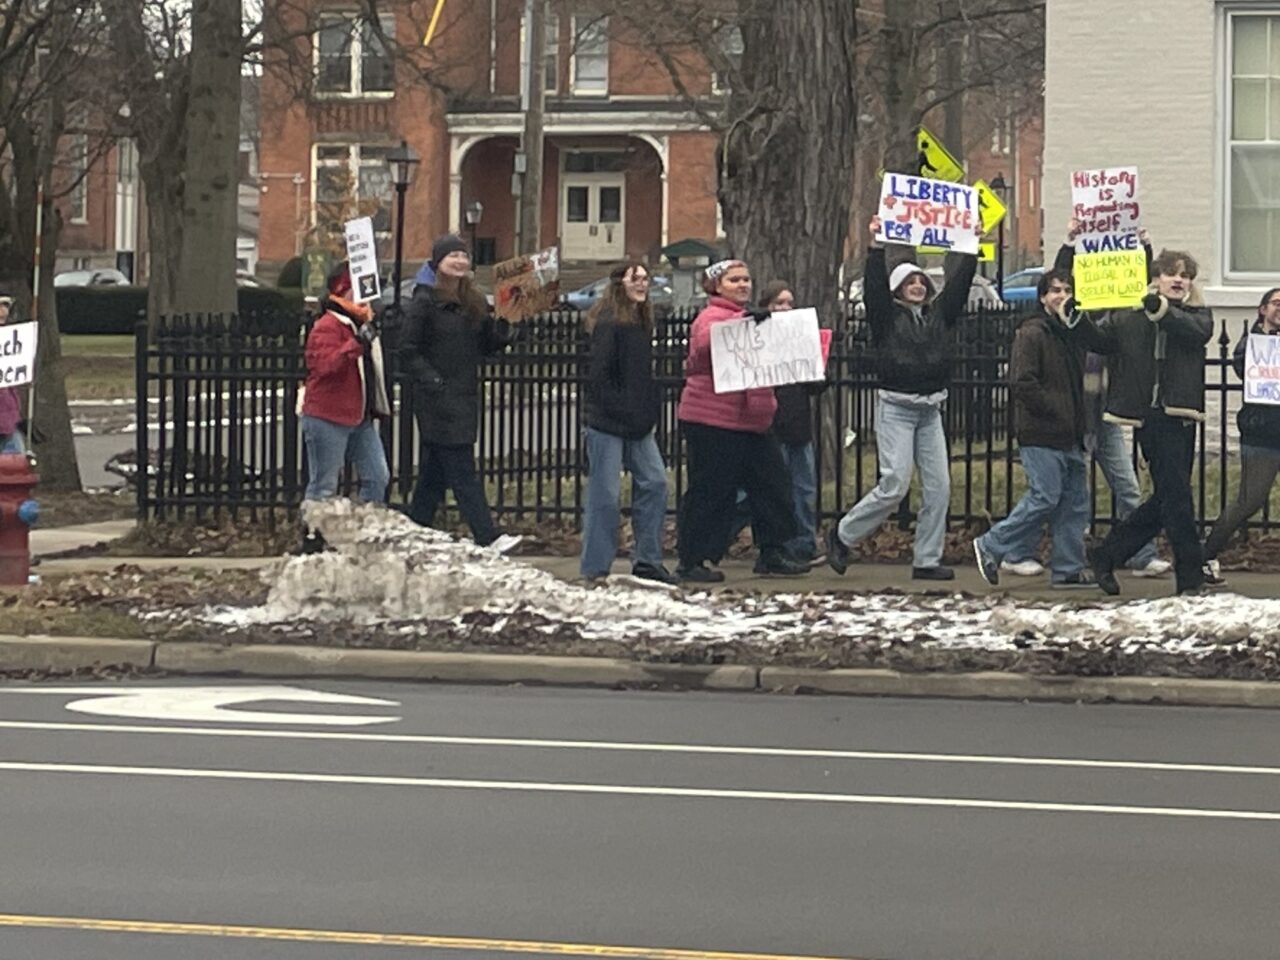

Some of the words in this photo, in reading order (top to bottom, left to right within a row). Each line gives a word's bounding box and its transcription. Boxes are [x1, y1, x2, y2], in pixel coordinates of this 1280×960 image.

[891, 176, 971, 209] LIBERTY
[1073, 170, 1136, 198] History
[885, 221, 912, 240] FOR
[1082, 233, 1138, 253] WAKE
